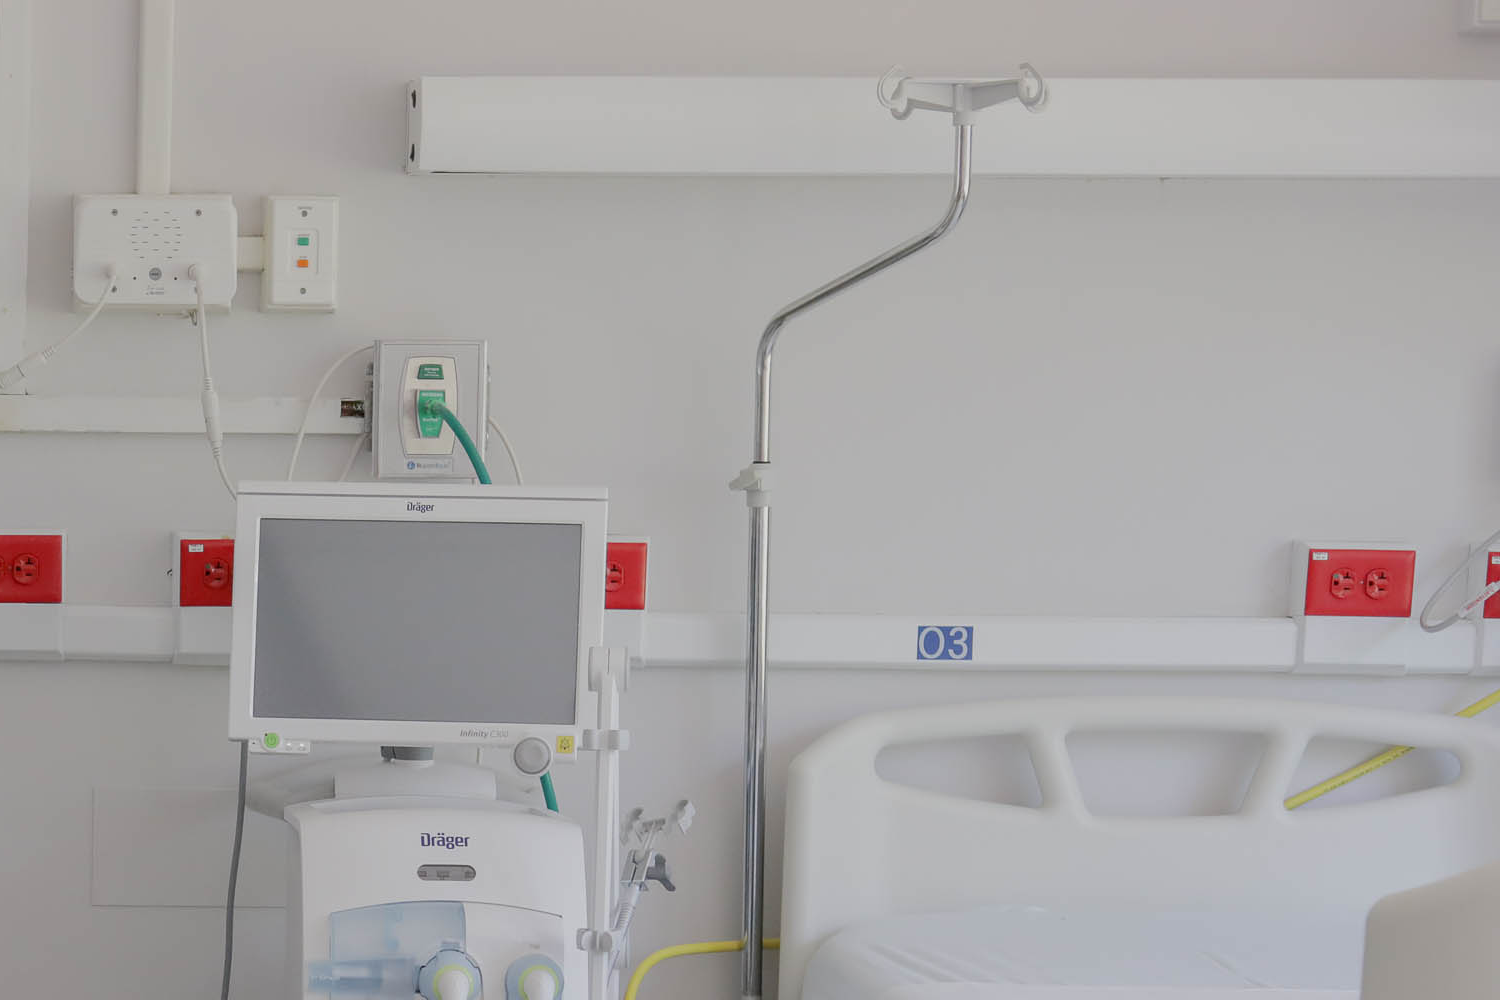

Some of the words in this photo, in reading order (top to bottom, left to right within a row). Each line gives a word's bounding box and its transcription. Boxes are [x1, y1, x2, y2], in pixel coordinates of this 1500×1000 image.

[406, 501, 436, 513] Dräger
[918, 626, 968, 659] 03
[460, 728, 489, 739] Infinity
[420, 832, 470, 849] Dräger
